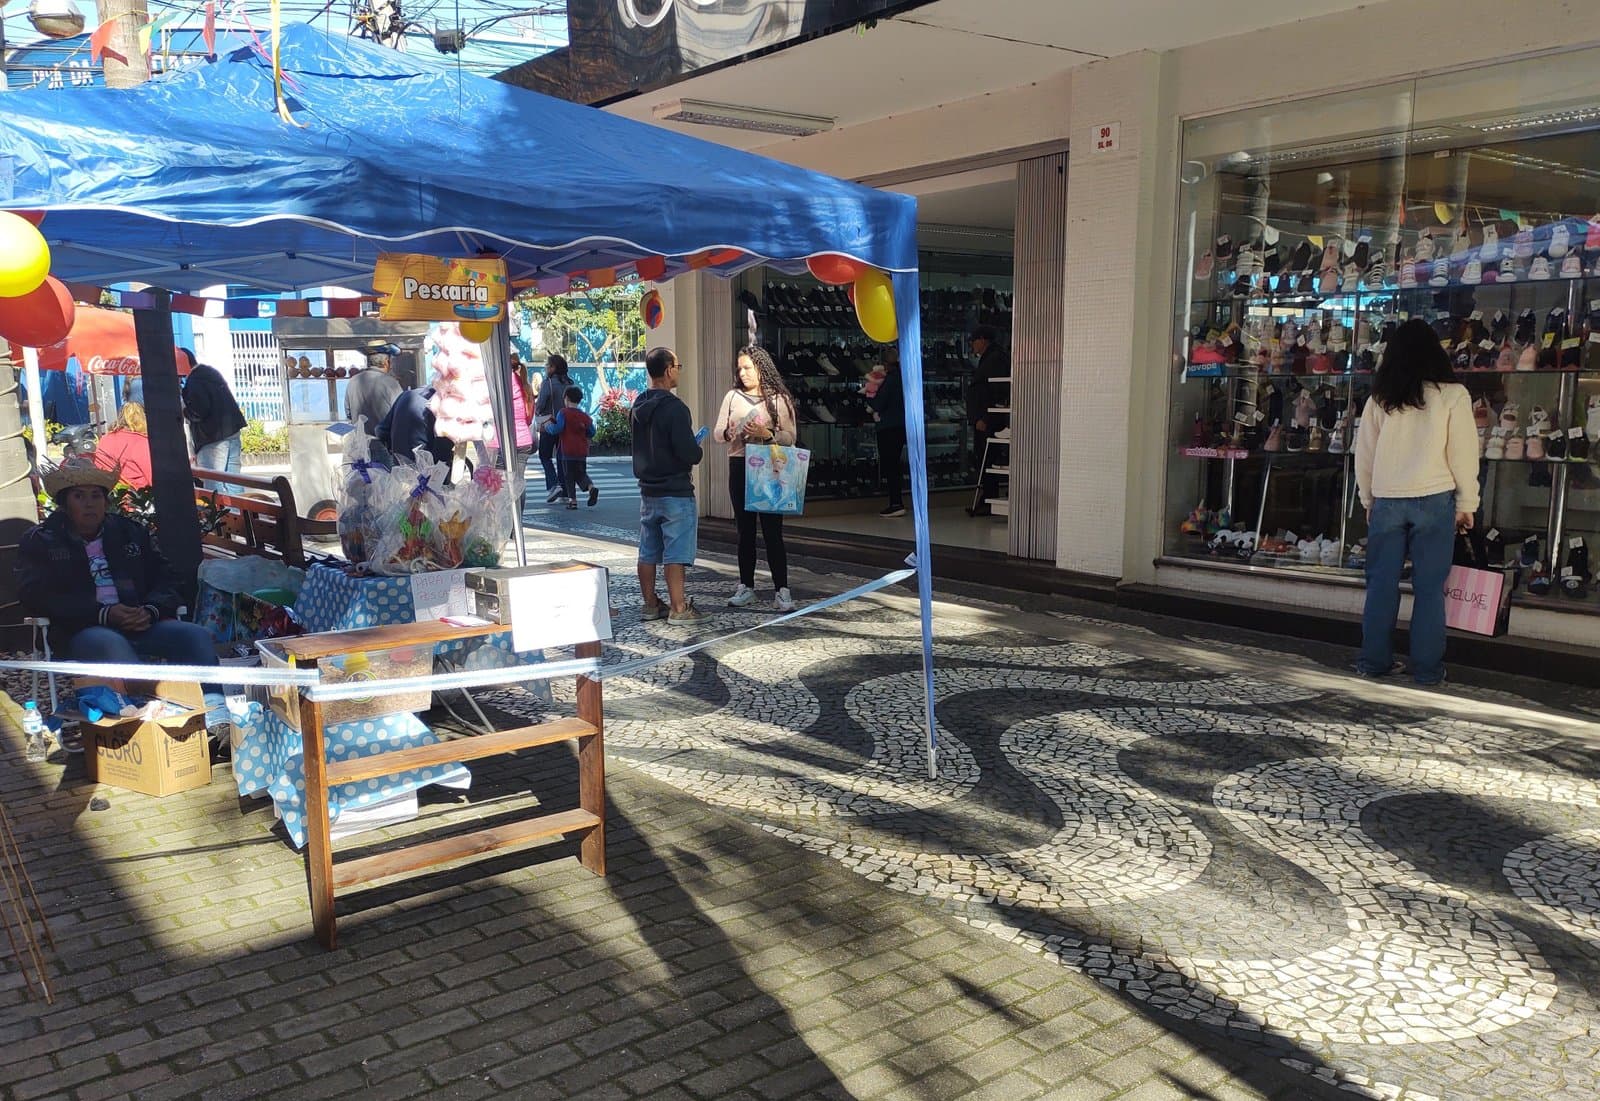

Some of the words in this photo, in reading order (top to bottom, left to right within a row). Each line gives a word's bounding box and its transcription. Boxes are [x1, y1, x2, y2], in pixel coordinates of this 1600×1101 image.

[1100, 127, 1110, 138] 90
[403, 276, 489, 302] Pescaria
[88, 355, 142, 376] Coca-Col
